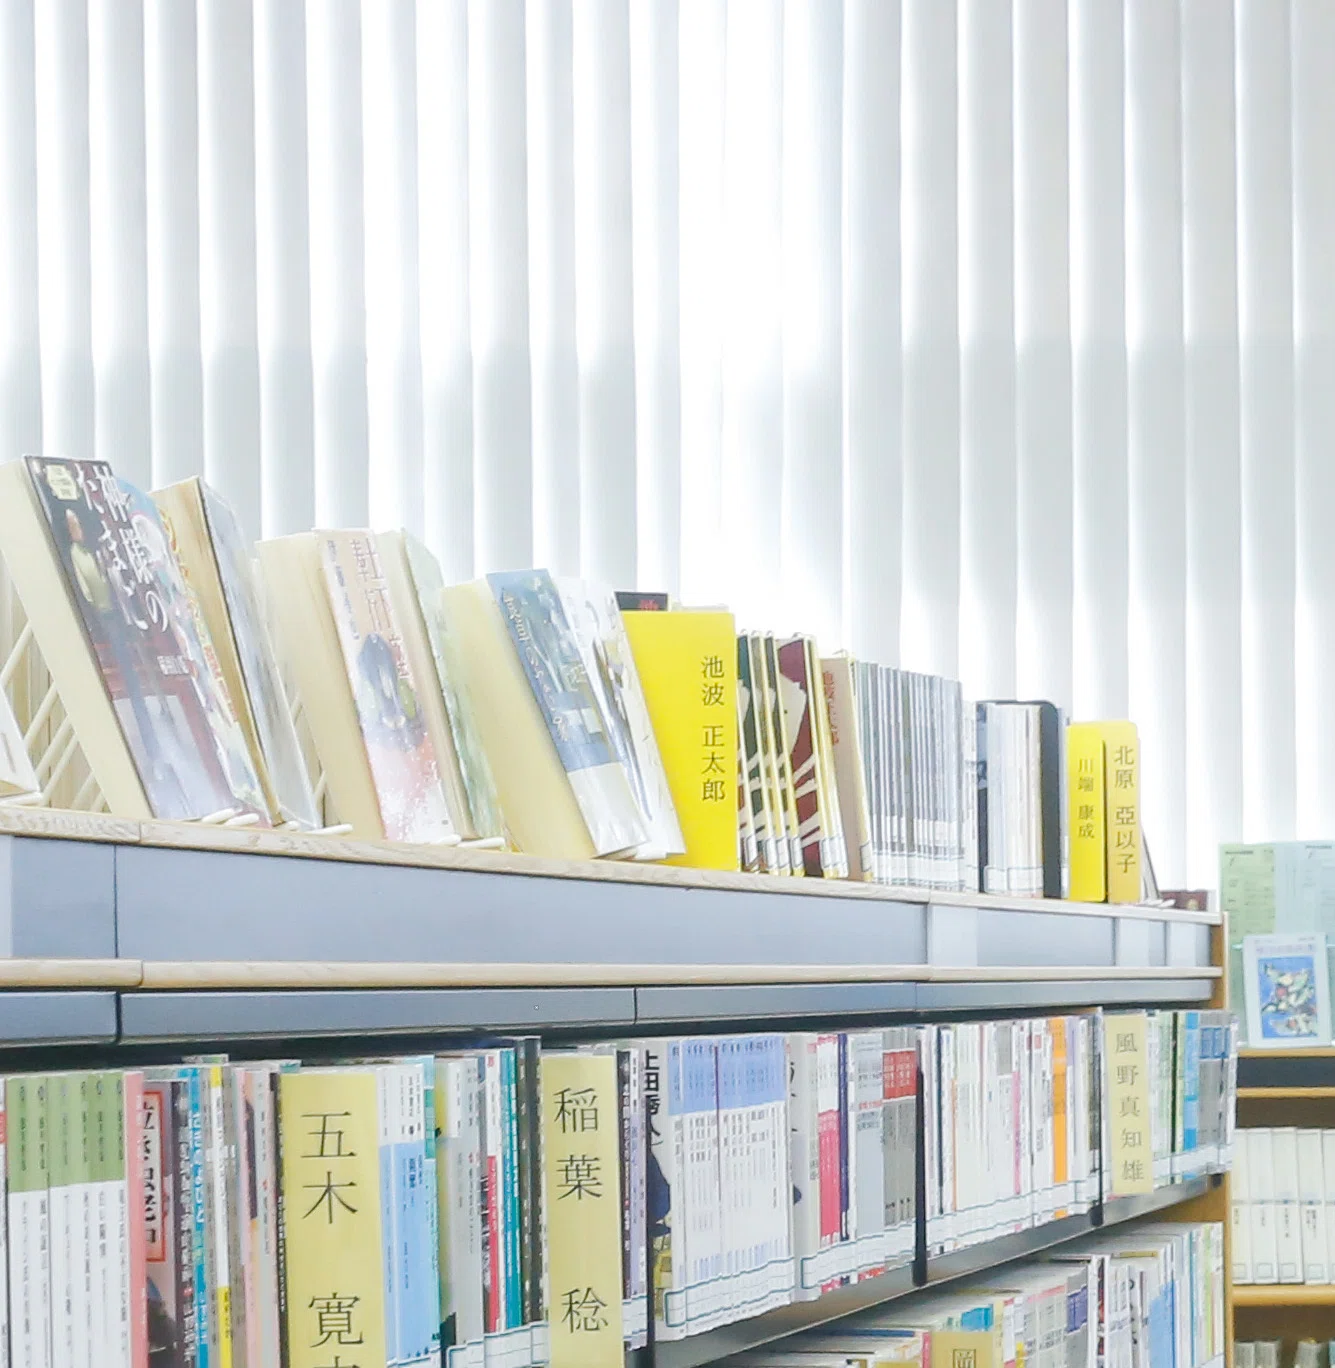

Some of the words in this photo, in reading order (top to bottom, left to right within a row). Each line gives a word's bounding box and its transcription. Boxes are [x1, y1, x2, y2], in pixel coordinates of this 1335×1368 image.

[701, 655, 725, 706] 池波
[701, 724, 726, 802] 正太郎
[1077, 758, 1095, 793] 川端
[1113, 745, 1135, 790] 北原
[1078, 804, 1095, 839] 康成
[1113, 805, 1137, 877] 亞以子
[1115, 1032, 1144, 1184] 風野真知雄
[301, 1111, 359, 1225] 五木
[553, 1087, 603, 1201] 稲葉
[561, 1287, 609, 1334] 稔
